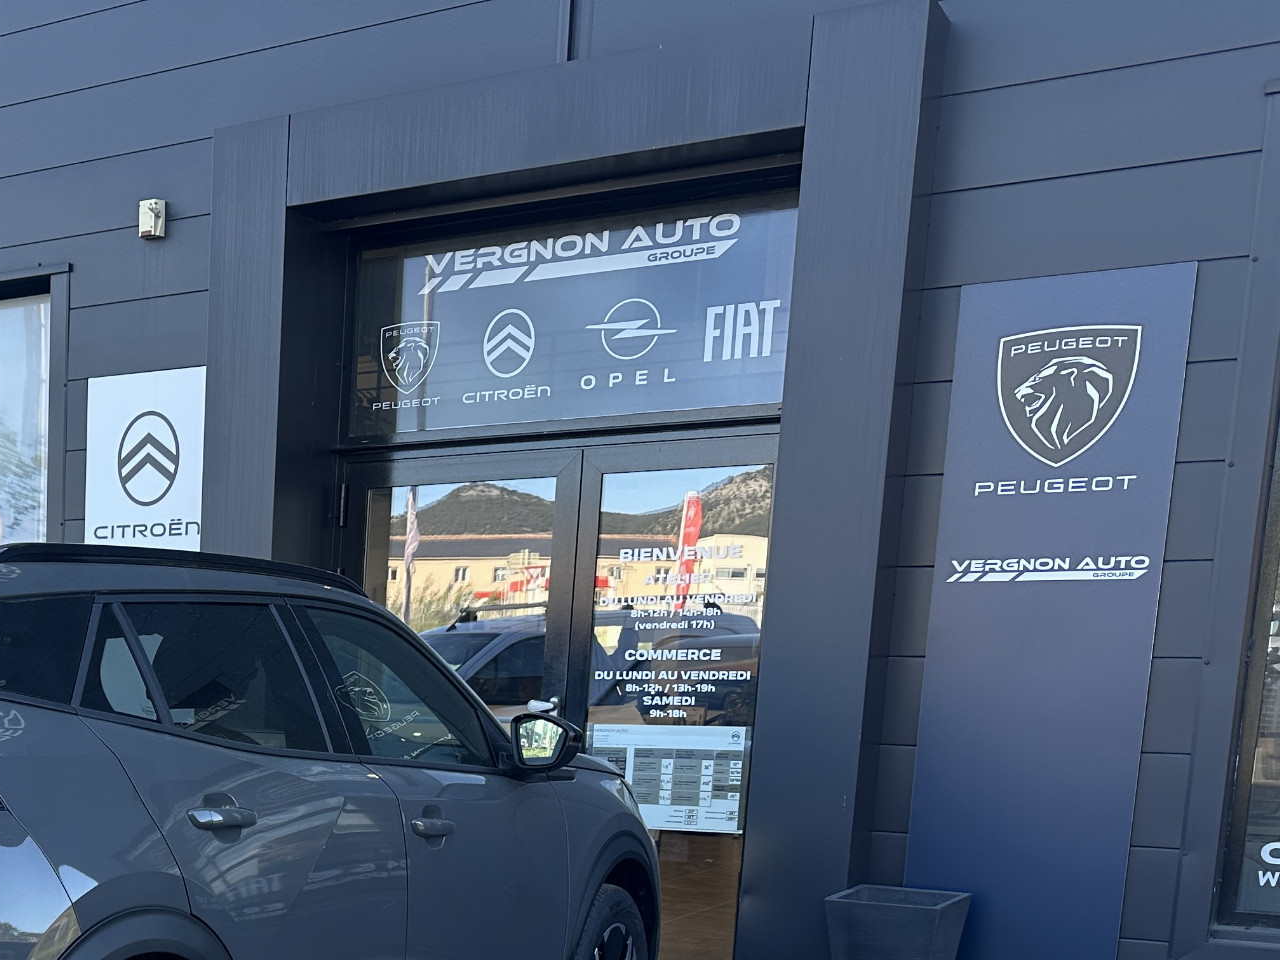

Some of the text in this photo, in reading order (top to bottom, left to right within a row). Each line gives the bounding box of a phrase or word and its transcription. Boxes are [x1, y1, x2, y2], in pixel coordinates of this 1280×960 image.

[424, 213, 741, 275] VERGNON AUTO
[646, 245, 717, 263] GROUPE
[385, 325, 436, 338] PEUGEOT
[703, 299, 781, 363] FIAT
[1009, 335, 1129, 357] PEUGEOT
[579, 368, 677, 391] OPEL
[372, 396, 441, 411] PEUGEOT
[973, 475, 1138, 497] PEUGEOT
[619, 545, 743, 562] BIENVENUE
[950, 555, 1151, 573] VERGNON AUTO
[644, 573, 713, 585] ATELIER
[1091, 571, 1136, 579] GROUPE
[599, 593, 757, 606] DU LUNDI AU VENDREDI
[630, 609, 668, 618] 8h-12h
[679, 608, 721, 617] 14h-18h
[634, 619, 716, 631] (vendredi 17h)
[624, 649, 722, 661] COMMERCE
[594, 671, 751, 680] DU LUNDI AU VENDREDI
[625, 684, 662, 693] 8h-12h
[672, 684, 716, 692] 13h-19h
[642, 696, 696, 706] SAMEDI
[649, 709, 687, 718] 9h-18h
